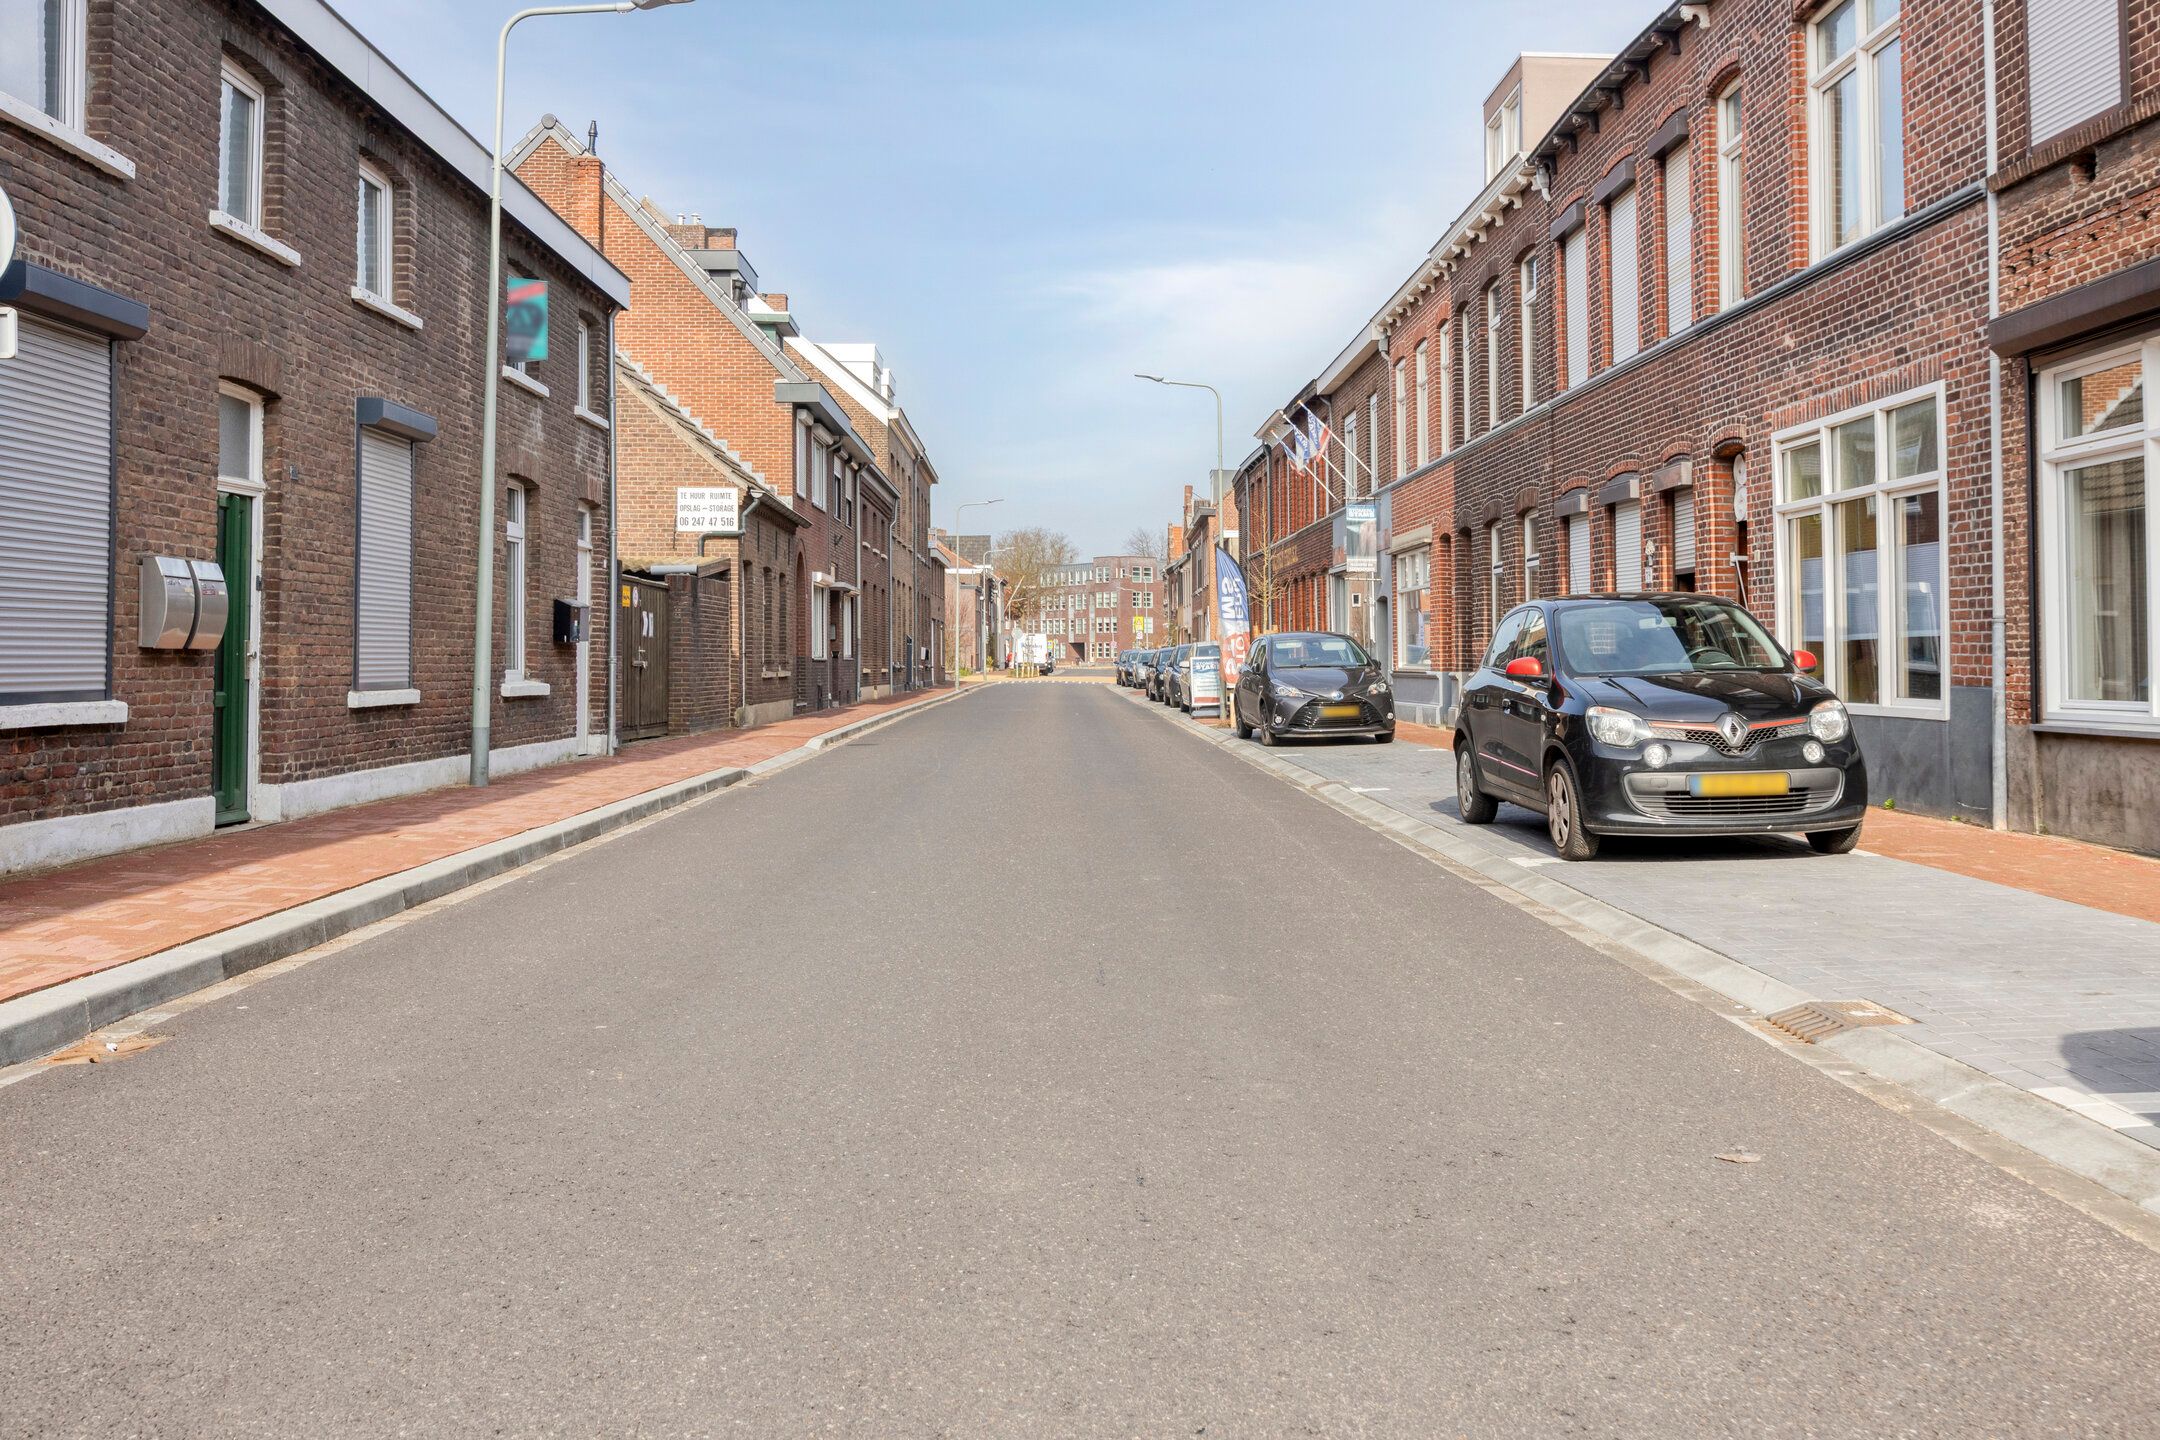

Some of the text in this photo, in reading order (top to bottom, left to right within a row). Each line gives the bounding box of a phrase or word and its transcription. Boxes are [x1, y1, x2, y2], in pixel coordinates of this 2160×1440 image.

[680, 492, 732, 500] TE HUUR RUIMTE
[679, 517, 734, 527] 06 247 47 516
